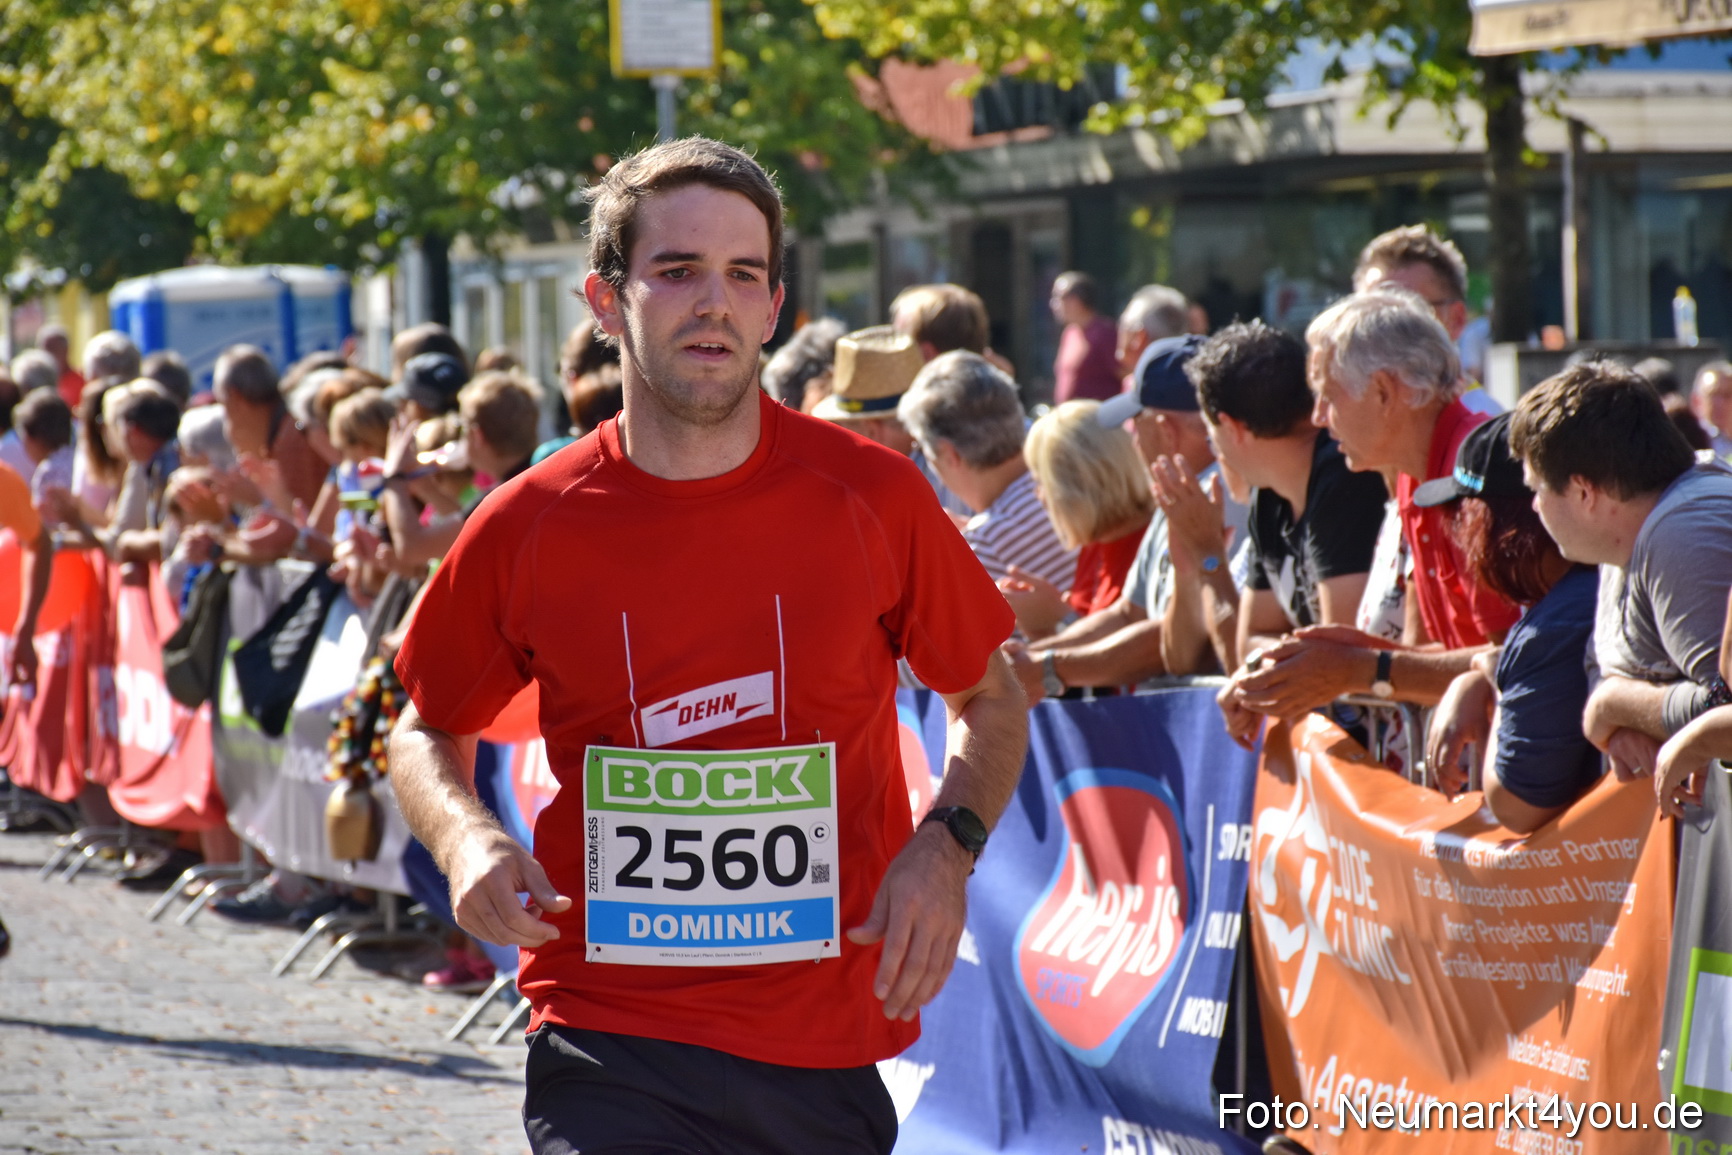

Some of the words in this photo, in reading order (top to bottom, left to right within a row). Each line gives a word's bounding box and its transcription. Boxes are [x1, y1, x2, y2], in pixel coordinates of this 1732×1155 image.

[677, 691, 738, 727] DEHN
[604, 757, 813, 806] BOCK
[814, 826, 825, 839] C
[1562, 836, 1640, 864] Partner
[615, 824, 809, 892] 2560
[1413, 867, 1432, 897] für
[1433, 872, 1454, 902] die
[1452, 874, 1535, 915] Konzeption
[1536, 877, 1576, 905] und
[628, 909, 795, 941] DOMINIK
[1029, 842, 1181, 998] hervis
[1441, 912, 1474, 943] Ihrer
[1474, 918, 1553, 951] Projekte
[1552, 921, 1588, 944] was
[1531, 954, 1564, 982] und
[1313, 1054, 1439, 1137] Agentur
